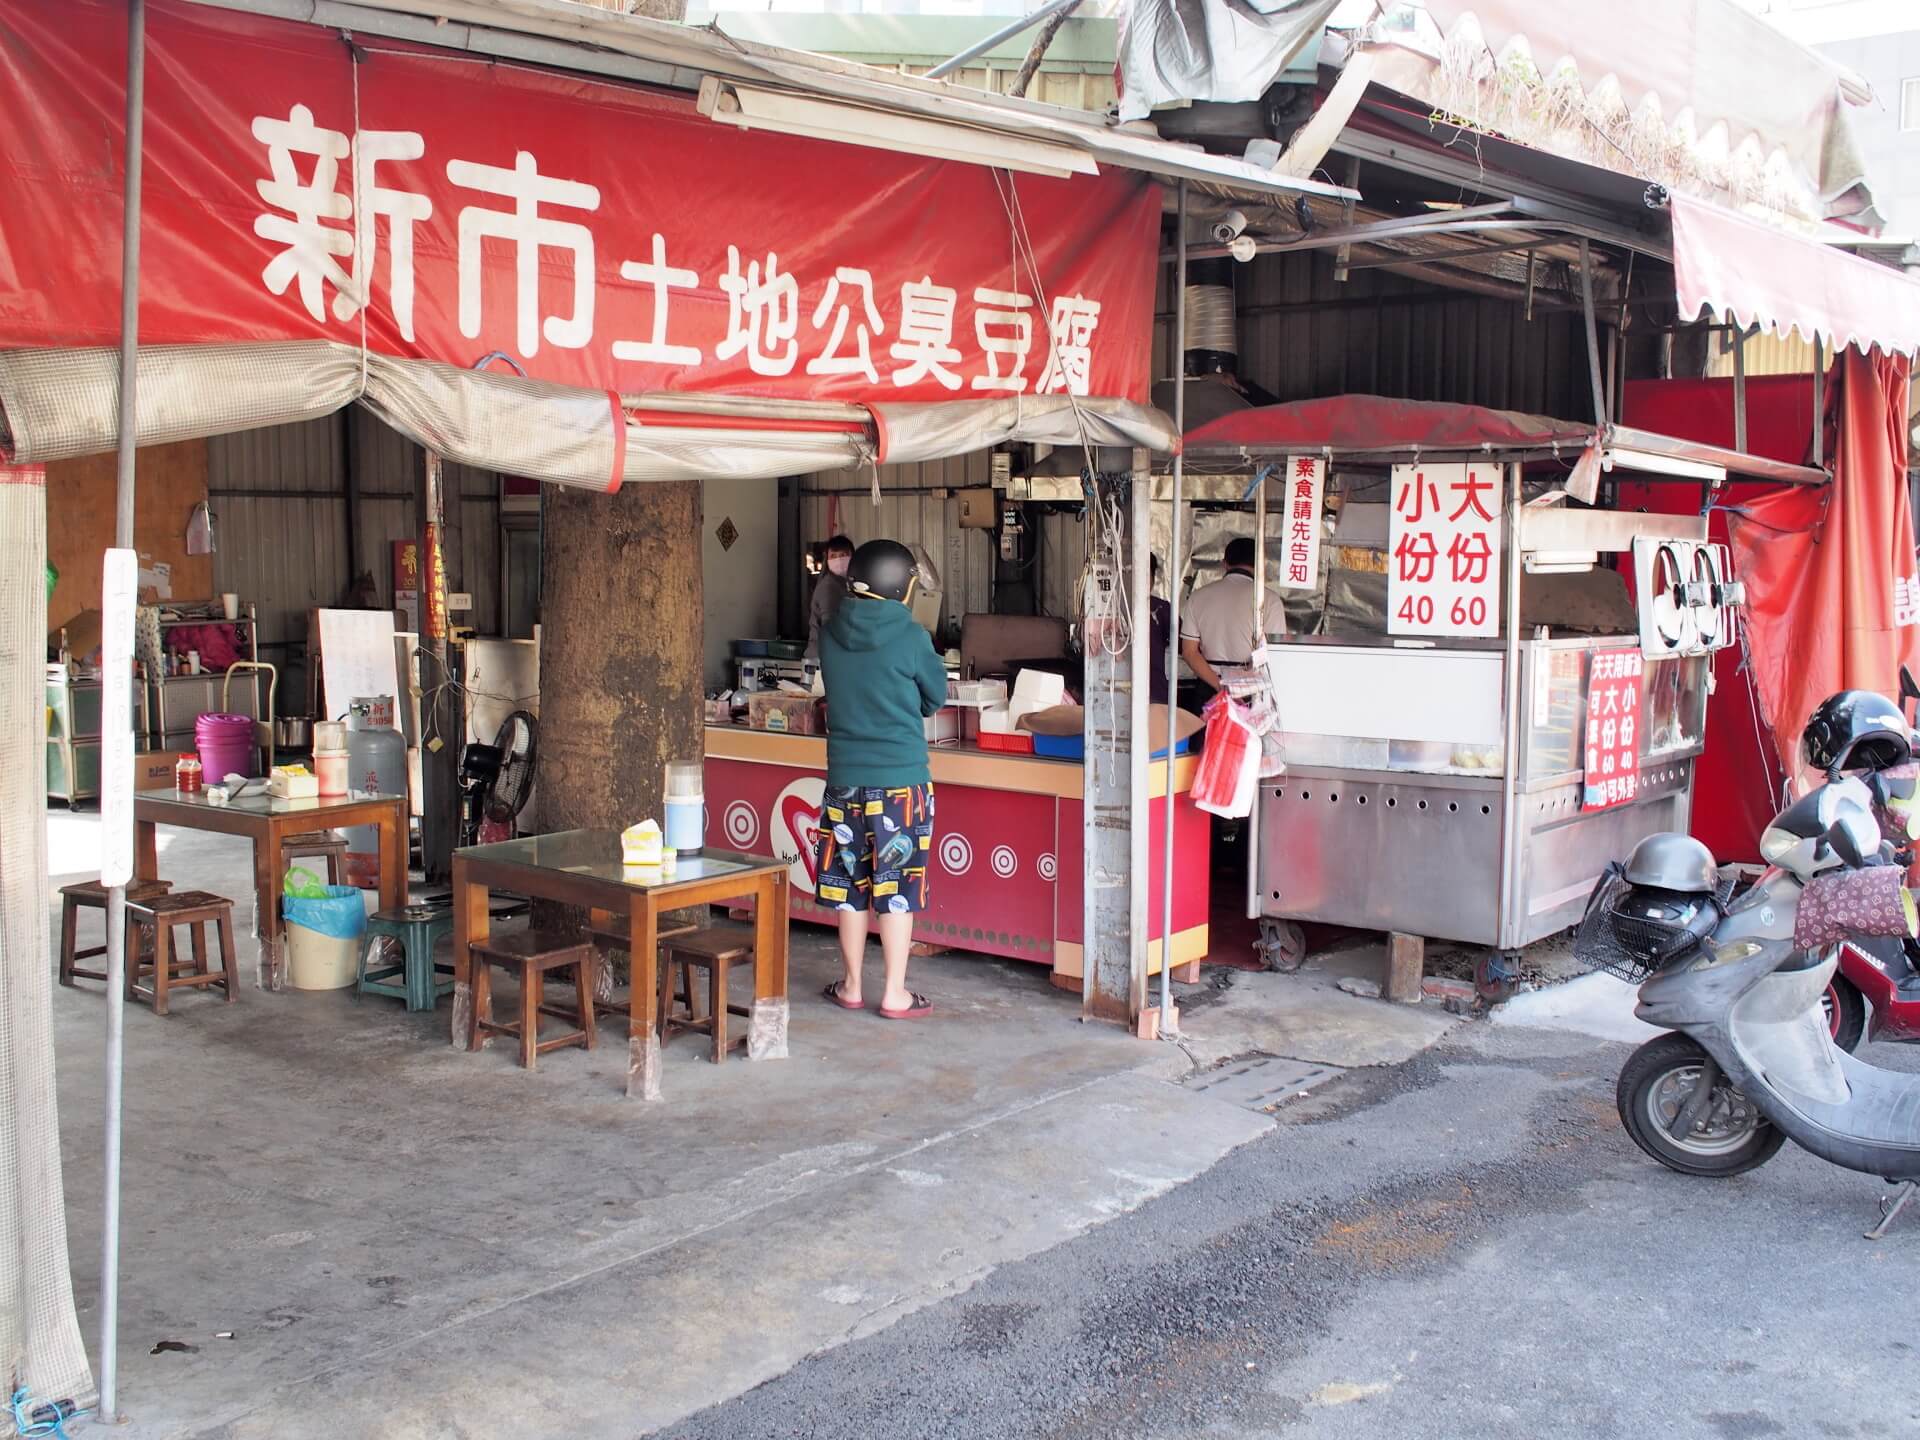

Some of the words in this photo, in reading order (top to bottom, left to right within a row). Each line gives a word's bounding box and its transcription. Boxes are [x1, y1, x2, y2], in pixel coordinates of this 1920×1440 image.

[252, 103, 1101, 396] 新市土地公臭豆腐
[1289, 458, 1316, 582] 素食請先告知
[1395, 472, 1440, 583] 小份
[1447, 472, 1494, 584] 大份
[1398, 595, 1434, 625] 40
[1450, 596, 1486, 626] 60
[1592, 653, 1642, 682] 天天用新油
[1587, 690, 1601, 774] 可素食
[1602, 684, 1619, 750] 大份
[1620, 682, 1637, 747] 小份
[1602, 753, 1615, 775] 60
[1620, 750, 1633, 770] 40
